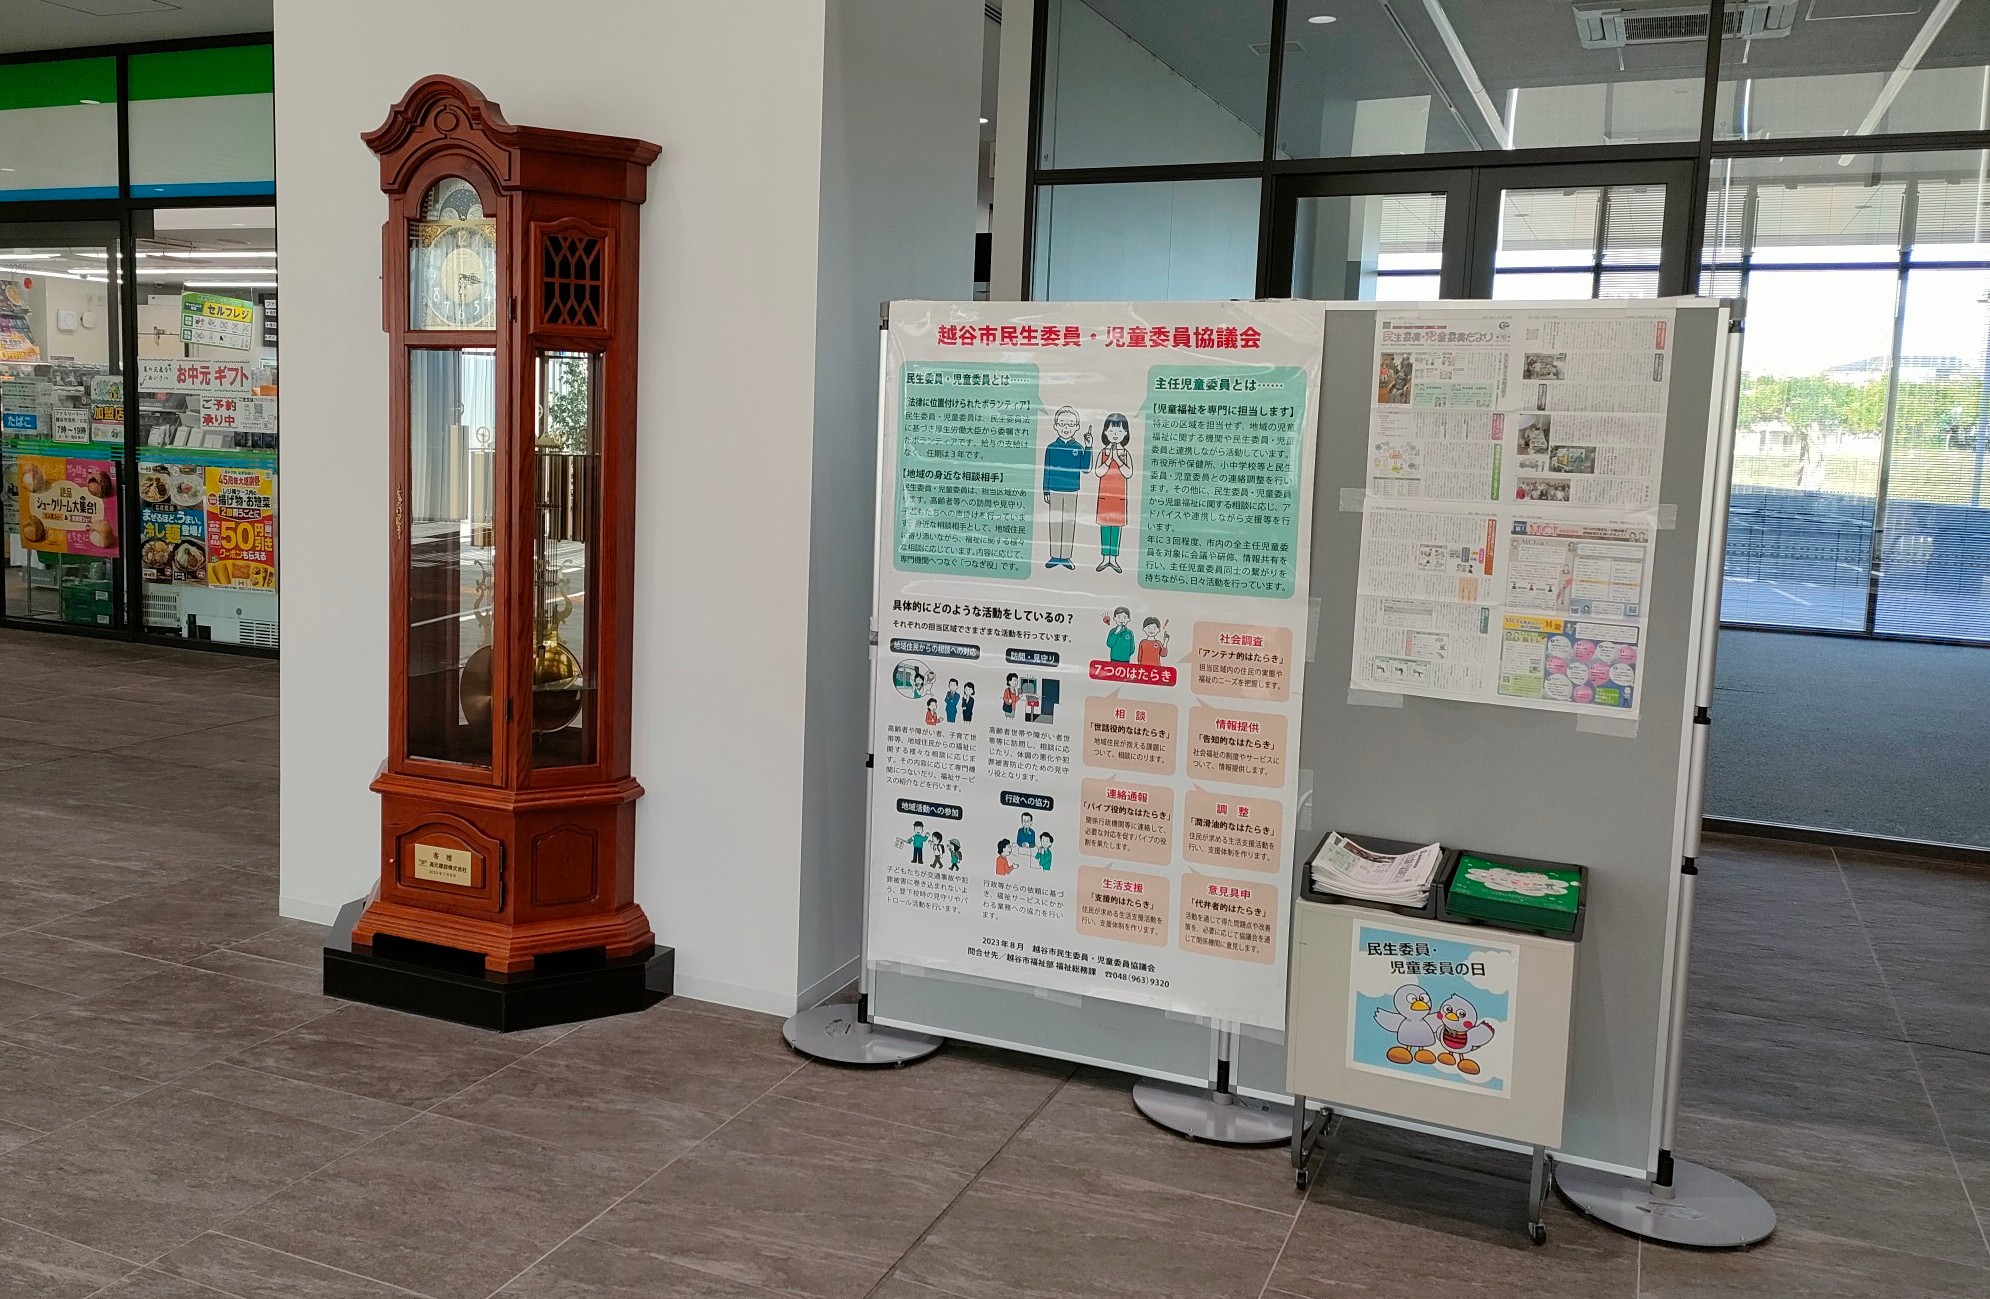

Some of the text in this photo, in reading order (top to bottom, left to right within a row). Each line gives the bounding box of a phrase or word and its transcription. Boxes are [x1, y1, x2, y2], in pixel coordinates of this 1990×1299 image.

[433, 287, 440, 301] 8
[208, 304, 249, 320] セルフレジ
[444, 301, 450, 314] 7
[458, 307, 465, 320] 6
[473, 301, 480, 314] 5
[937, 325, 1262, 349] 越谷市民生委員・児童委員協議会
[177, 364, 249, 387] お中元 ギフト
[93, 405, 124, 420] 加盟店
[202, 398, 236, 412] ご予約
[1153, 403, 1295, 418] 【児童福祉を専門に担当します】
[8, 416, 32, 427] たばこ
[202, 414, 235, 426] 承り中
[905, 412, 1030, 424] 民生委員・児童委員は、民生委員法
[1152, 418, 1295, 432] 特定の区域を担当せず、地域の児童
[904, 424, 1030, 436] に基づき厚生労働大臣から委嘱され
[904, 436, 1029, 448] たボランティアです。給与の支給は
[1152, 432, 1295, 446] 福祉に関する機関や民生委員・児童
[1151, 446, 1290, 459] 委員と連携しながら活動しています。
[1150, 458, 1294, 472] 市役所や保健所、小中学校等と民生
[902, 468, 1004, 483] 【地域の身近な相談相手】
[1150, 470, 1293, 486] 委員・児童委員との連絡調整を行い
[1150, 484, 1292, 498] ます。その他に、民生委員・児童委員
[218, 494, 270, 508] 揚げ物・お惣菜
[1149, 498, 1290, 512] から児童福祉に関する相談に応じ、ア
[143, 508, 202, 524] まぜるほど、うまい。
[220, 508, 260, 518] 2個買うごとに
[902, 507, 1026, 522] 子どもたちへの声掛けを行っていま
[1148, 511, 1290, 526] ドバイスや連携しながら支援等を行
[1148, 522, 1175, 532] います。
[1529, 524, 1559, 536] MCI
[220, 522, 254, 550] 50
[901, 531, 1025, 546] に寄り添いながら、福祉に関する様々
[220, 549, 266, 560] クーポンもらえる
[900, 544, 1024, 560] な相談に応じています。内容に応じて、
[1146, 548, 1288, 565] 員を対象に会議や研修、情報共有を
[900, 556, 1020, 572] 専門機関へつなぐ「つなぎ役」です。
[1146, 561, 1287, 578] 行い、主任児童委員同士の繋がりを
[1145, 573, 1286, 592] 持ちながら、日々活動を行っています。
[892, 600, 1074, 624] 具体的にどのような活動をしているの？
[892, 620, 1072, 643] それぞれの担当区域でさまざまな活動を行っています。
[1219, 632, 1264, 647] 社会調査
[894, 641, 977, 657] 地域住民からの相談への対応
[1198, 648, 1285, 665] 「アンテナ的はたらき」
[1010, 652, 1055, 664] 訪問・見守り
[1094, 664, 1172, 682] 7つのはたらき
[1199, 663, 1283, 678] 担当区域内の住民の実態や
[1198, 675, 1282, 690] 福祉のニーズを把握します。
[888, 724, 978, 742] 高齢者や障がい者、子育て世
[988, 726, 1070, 742] 高齢者世帯や障がい者世
[1090, 722, 1171, 740] 「世話役的なはたらき」
[1216, 718, 1260, 734] 情報提供
[887, 735, 976, 752] 帯等、地域住民からの福祉に
[988, 736, 1070, 753] 帯等に訪問し、相談に応
[1094, 737, 1166, 752] 地域住民が抱える課題に
[1198, 733, 1278, 752] 「告知的なはたらき」
[886, 746, 976, 762] 関する様々な相談に応じま
[988, 748, 1070, 764] じたり、体調の悪化や犯
[1093, 749, 1165, 764] ついて、相談にのります。
[1192, 748, 1280, 766] 社会福祉の制度やサービスに
[886, 756, 976, 774] す。その内容に応じて専門機
[988, 758, 1070, 774] 罪被害防止のための見守
[1192, 760, 1268, 776] ついて、情報提供します。
[886, 766, 976, 784] 関につないだり、福祉サービ
[988, 768, 1040, 782] り役となります。
[886, 776, 963, 792] スの紹介などを行います。
[1005, 794, 1050, 808] 行政への協力
[1106, 788, 1148, 804] 連絡通報
[901, 802, 959, 818] 地域活動への参加
[1083, 801, 1172, 822] 「パイプ役的なはたらき」
[1086, 816, 1168, 834] 関係行政機関等に連絡して、
[1190, 816, 1276, 837] 「潤滑油的なはたらき」
[1084, 838, 1132, 852] 割を果たします。
[1085, 828, 1167, 846] 必要な対応を促すパイプの役
[1189, 832, 1275, 850] 住民が求める生活支援活動を
[1188, 844, 1271, 862] 行い、支援体制を作ります。
[888, 866, 969, 884] 子どもたちが交通事故や犯
[886, 876, 968, 894] 罪被害に巻き込まれないよ
[983, 880, 1064, 898] 行政等からの依頼に基づ
[1102, 878, 1144, 894] 生活支援
[1208, 884, 1252, 900] 意見具申
[886, 886, 968, 904] う、登下校時の見守りやパ
[983, 890, 1064, 908] き、福祉サービスにかか
[1090, 892, 1155, 910] 「支援的はたらき」
[887, 896, 962, 914] トロール活動を行います。
[983, 901, 1064, 918] わる業務への協力を行い
[1190, 898, 1267, 918] 「代弁者的はたらき」
[982, 912, 1000, 920] ます。
[1082, 906, 1163, 924] 住民が求める生活支援活動を
[1185, 912, 1271, 932] 活動を通じて得た問題点や改善
[1082, 917, 1159, 936] 行い、支援体制を作ります。
[1184, 924, 1270, 943] 策を、必要に応じて協議会を通
[1184, 936, 1260, 954] じて関係機関に意見します。
[1367, 942, 1438, 957] 民生委員・
[982, 936, 1156, 973] 2023年8月 越谷市民生委員・児童委員協議会
[1056, 962, 1097, 976] 福祉総務課
[1390, 960, 1486, 976] 児童委員の日
